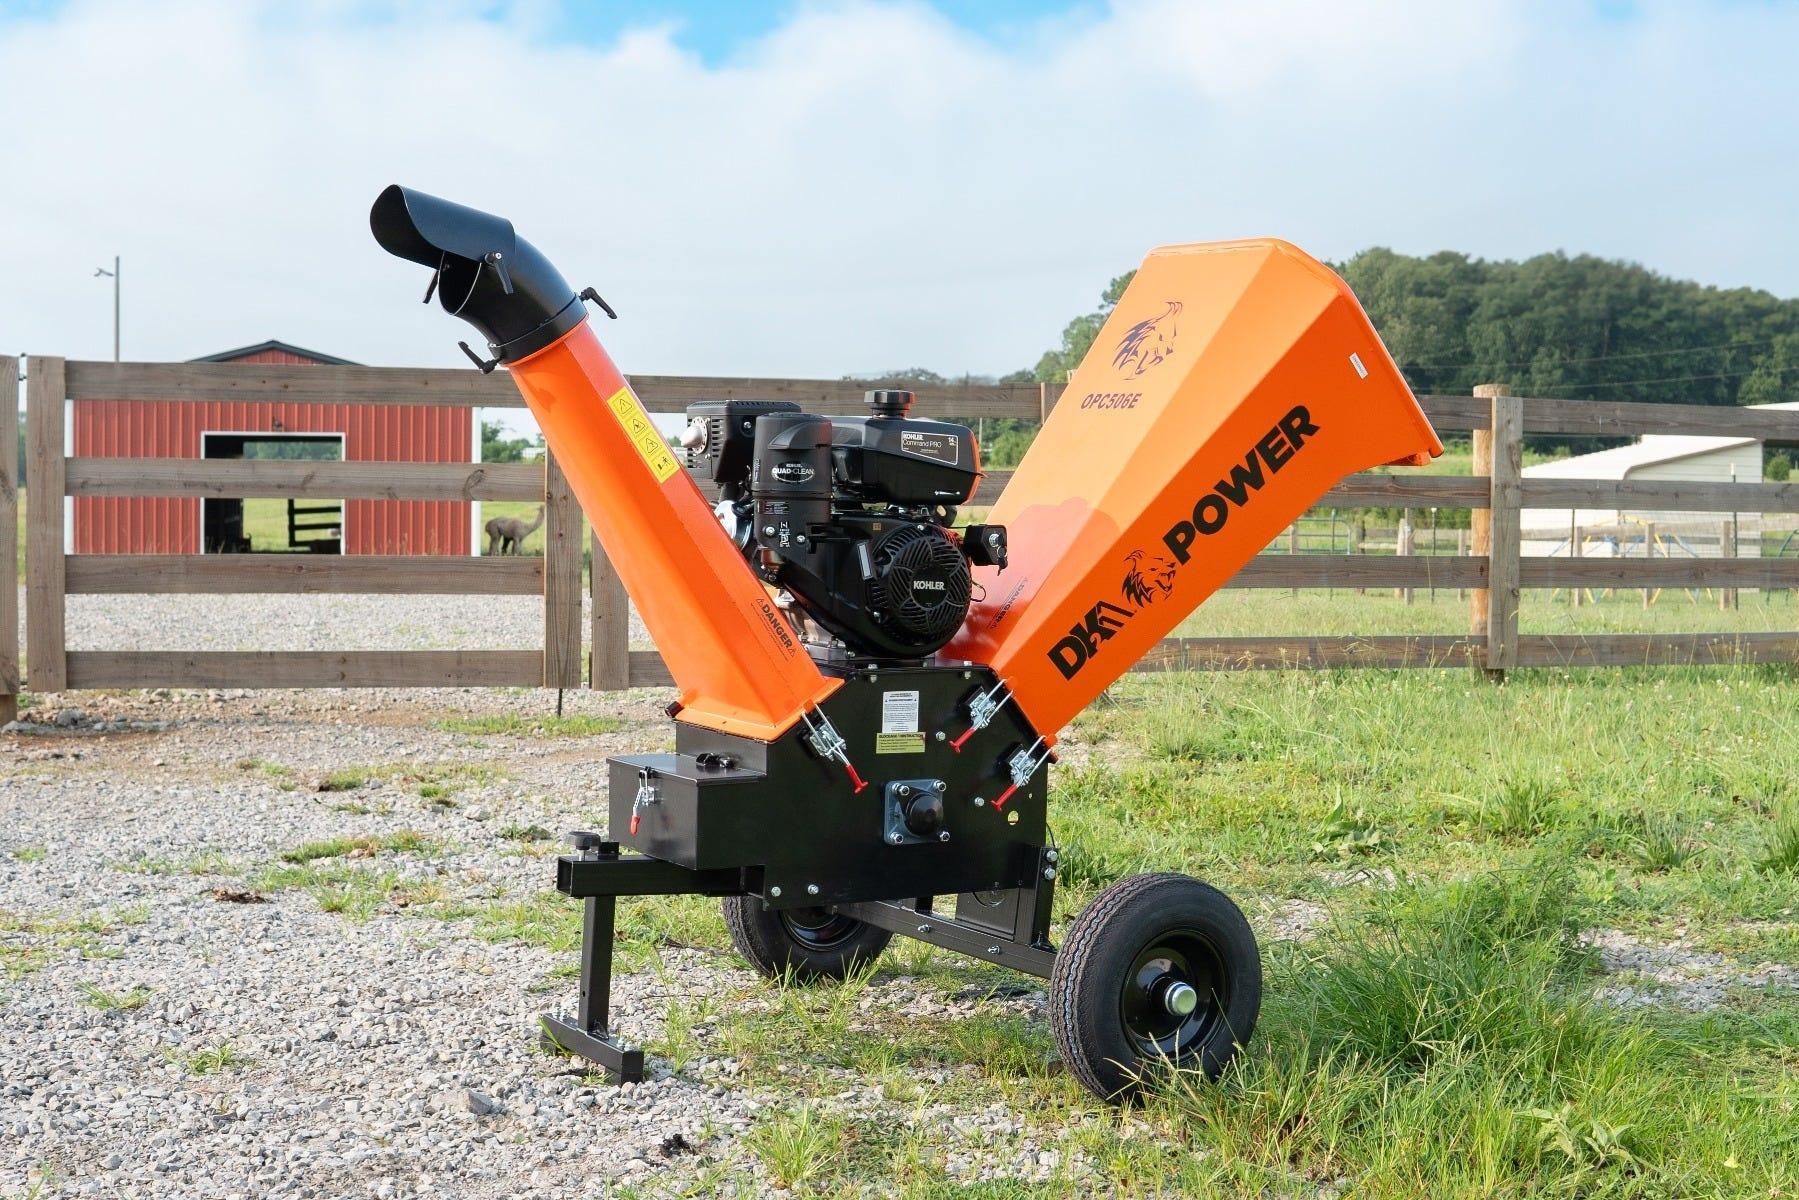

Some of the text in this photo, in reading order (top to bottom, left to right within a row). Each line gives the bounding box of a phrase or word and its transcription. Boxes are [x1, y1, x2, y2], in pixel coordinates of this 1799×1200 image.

[1080, 393, 1142, 409] OPC506E
[902, 433, 924, 441] KOHLER
[902, 439, 929, 447] Command
[1162, 405, 1320, 566] POWER
[913, 580, 946, 590] KOHLER
[761, 603, 793, 649] DANGER
